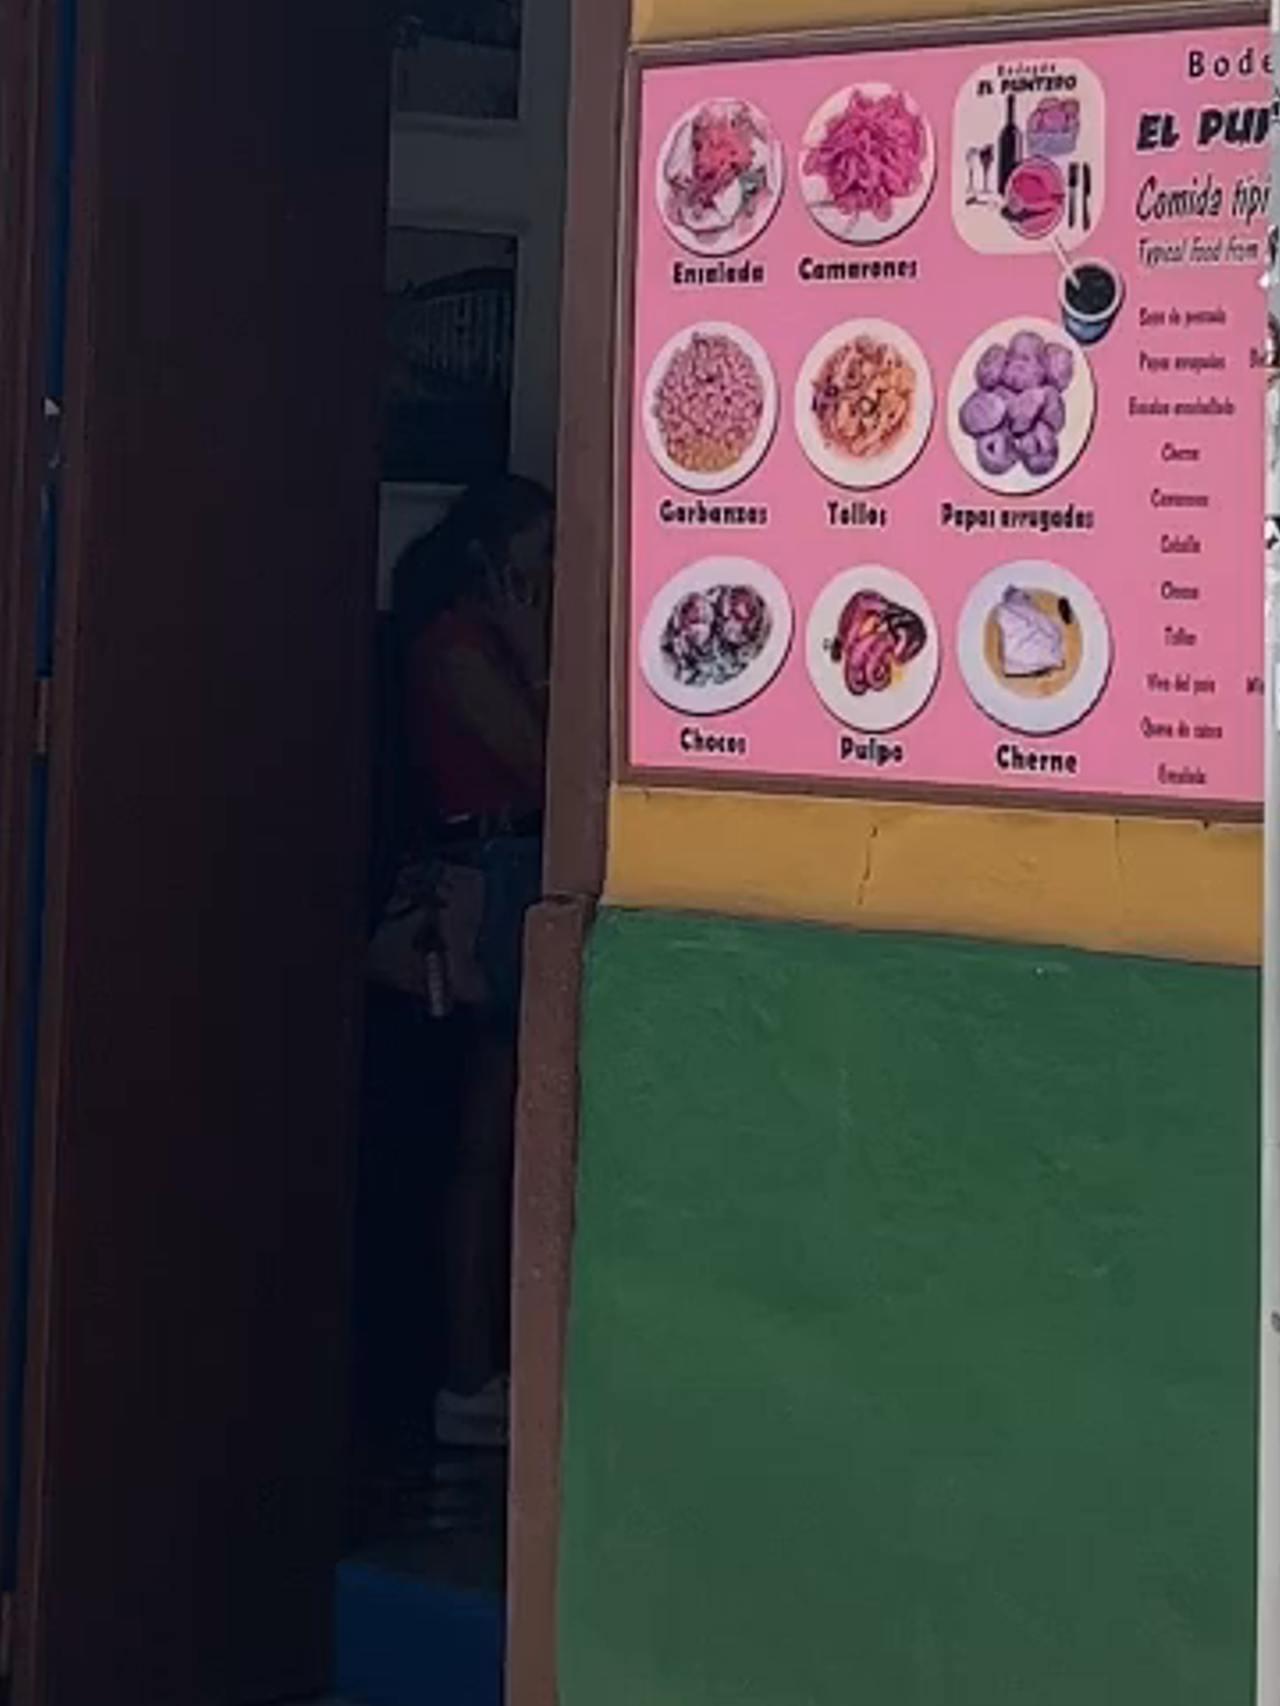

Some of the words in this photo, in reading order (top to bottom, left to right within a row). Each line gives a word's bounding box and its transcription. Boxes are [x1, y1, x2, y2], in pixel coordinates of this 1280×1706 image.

[1136, 113, 1180, 150] EL
[1136, 174, 1222, 221] Comida
[673, 260, 764, 285] Ensalada
[798, 257, 918, 281] Camarones
[941, 502, 995, 532] Papas
[1000, 503, 1095, 532] arrugadas
[841, 737, 904, 767] Pulpo
[996, 743, 1078, 774] Cherne
